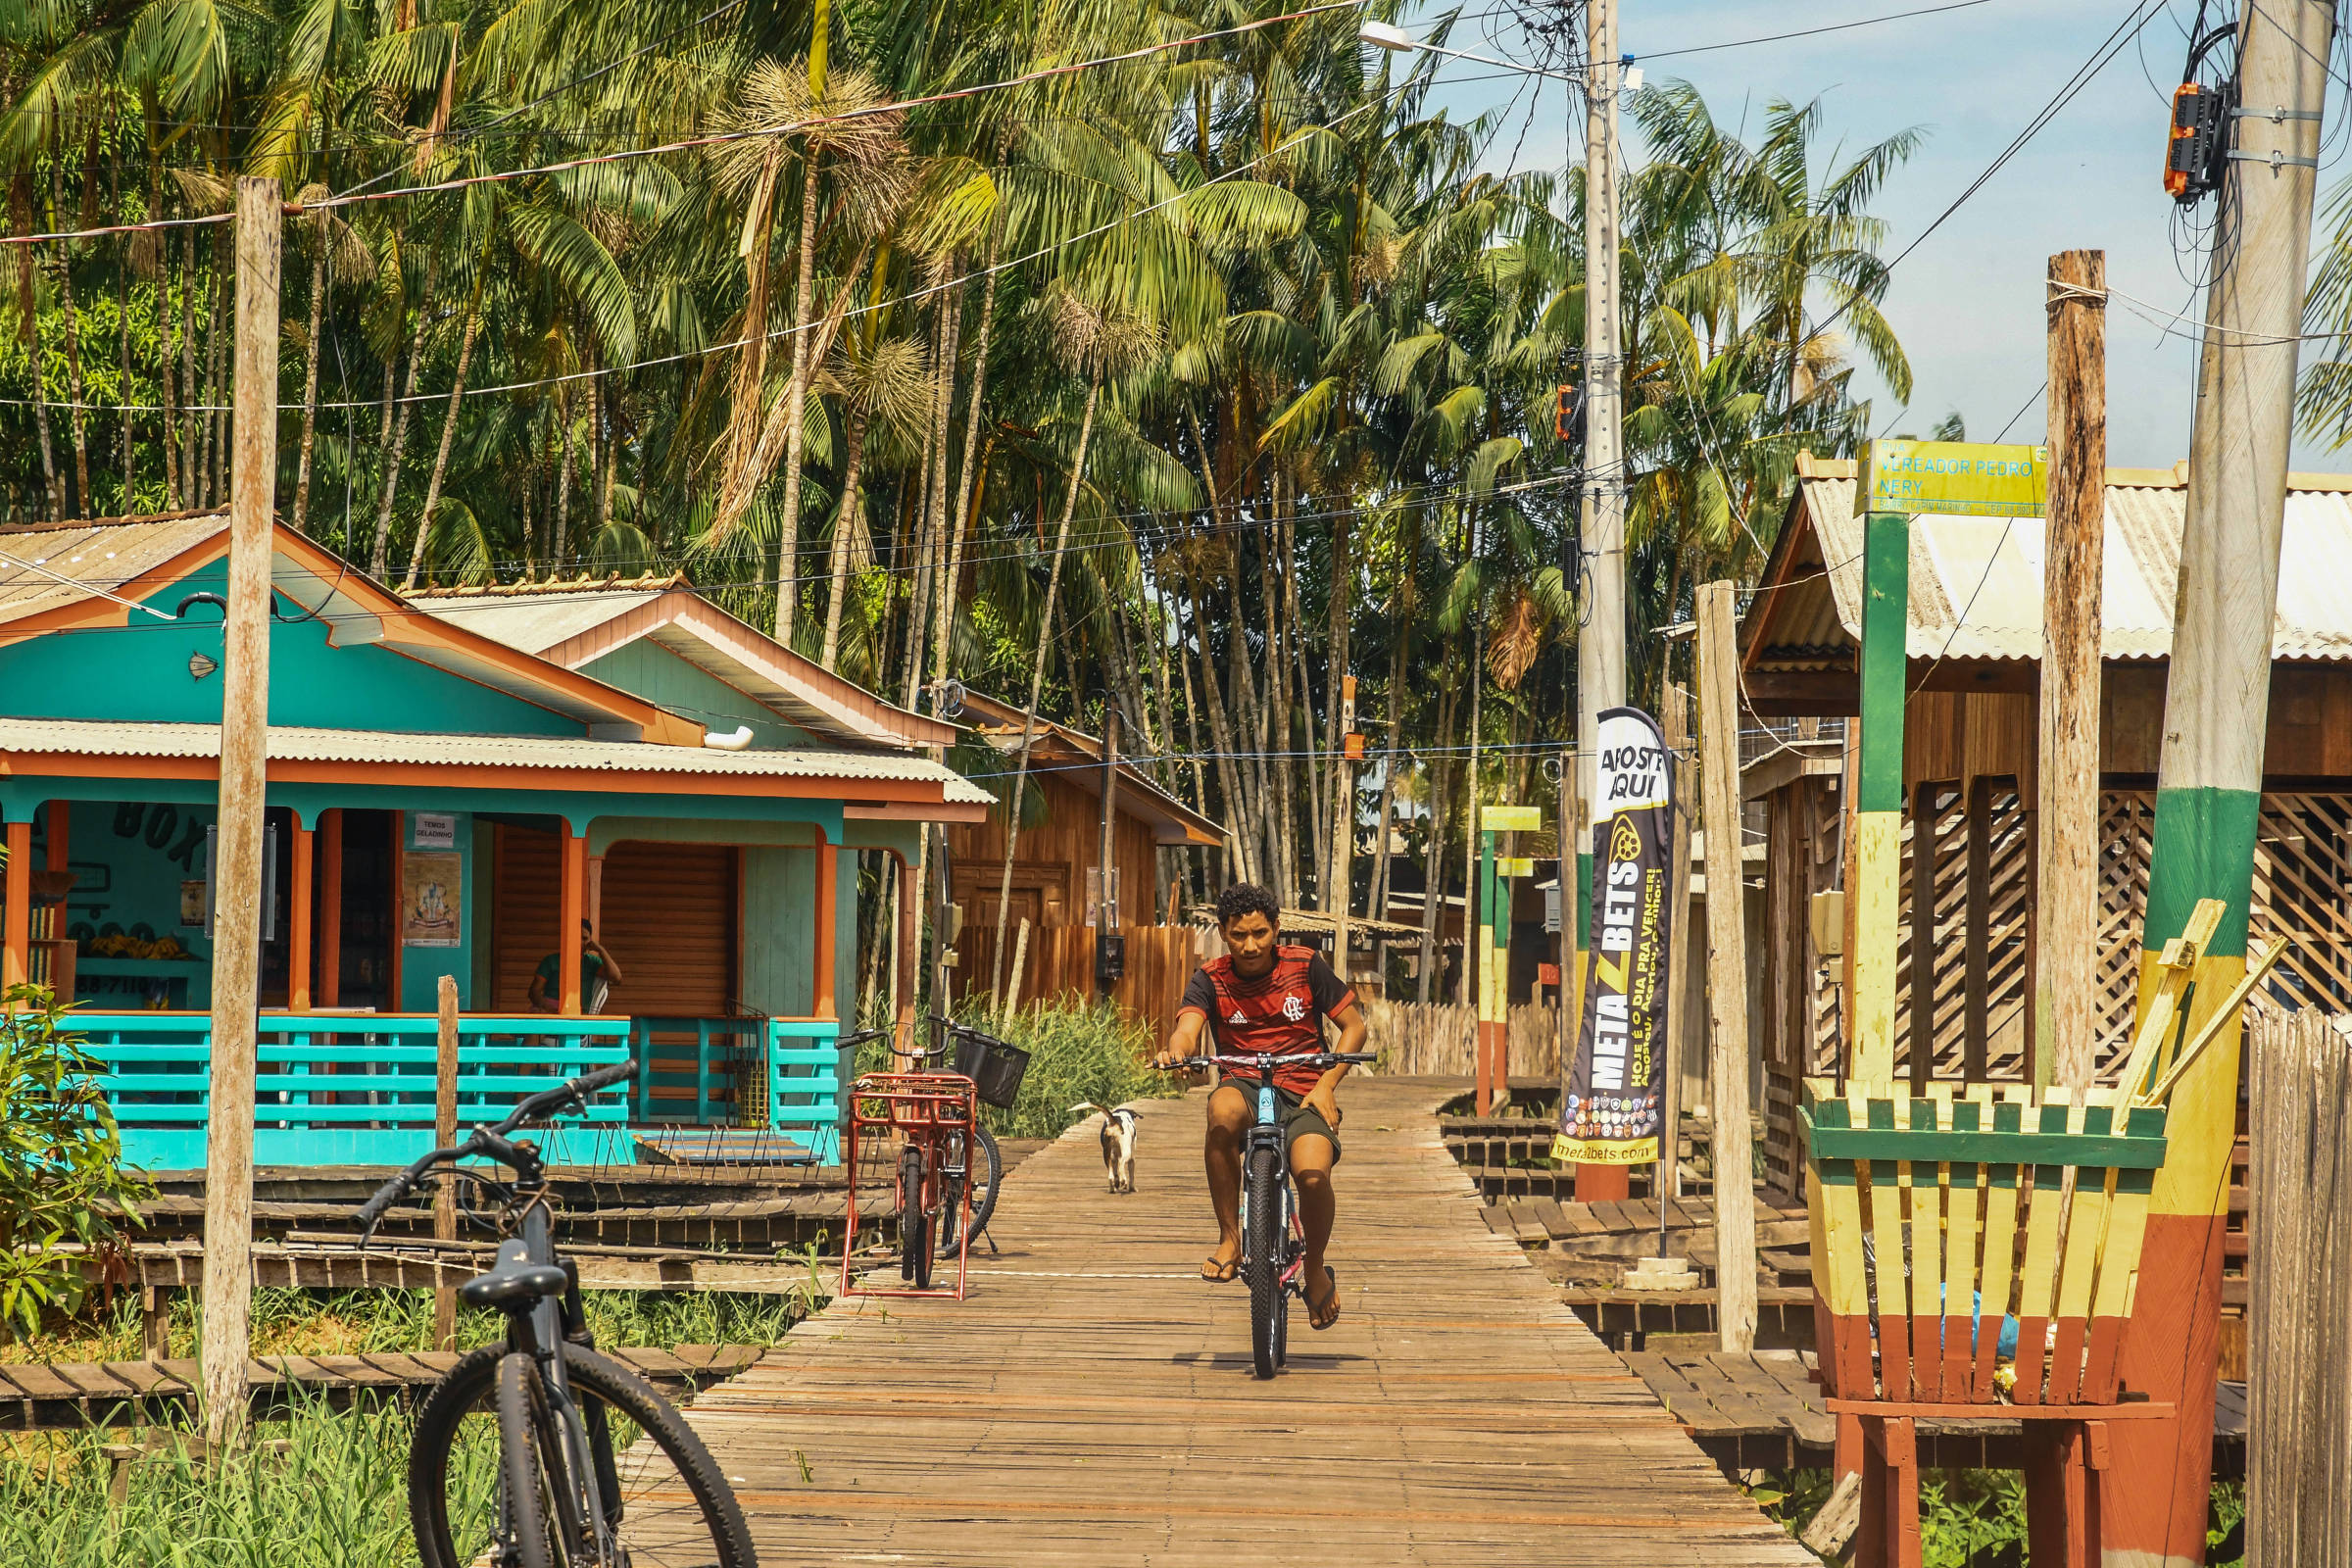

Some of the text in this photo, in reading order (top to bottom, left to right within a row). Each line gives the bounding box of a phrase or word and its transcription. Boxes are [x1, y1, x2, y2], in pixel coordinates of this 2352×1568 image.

[1882, 442, 1905, 452] RUA
[1881, 457, 2033, 477] VEREADOR PEDRO
[1880, 479, 1924, 495] NERY
[1879, 499, 1909, 511] BAIRRO
[1608, 773, 1656, 800] AQUI
[416, 829, 453, 839] GELADINHO
[1641, 868, 1656, 938] VENCER!
[1637, 942, 1652, 973] PRA
[1633, 977, 1647, 1006] DIA
[1632, 1010, 1642, 1025] O
[1631, 1044, 1644, 1088] HOJE
[1556, 1144, 1650, 1160] meta2bets.com
